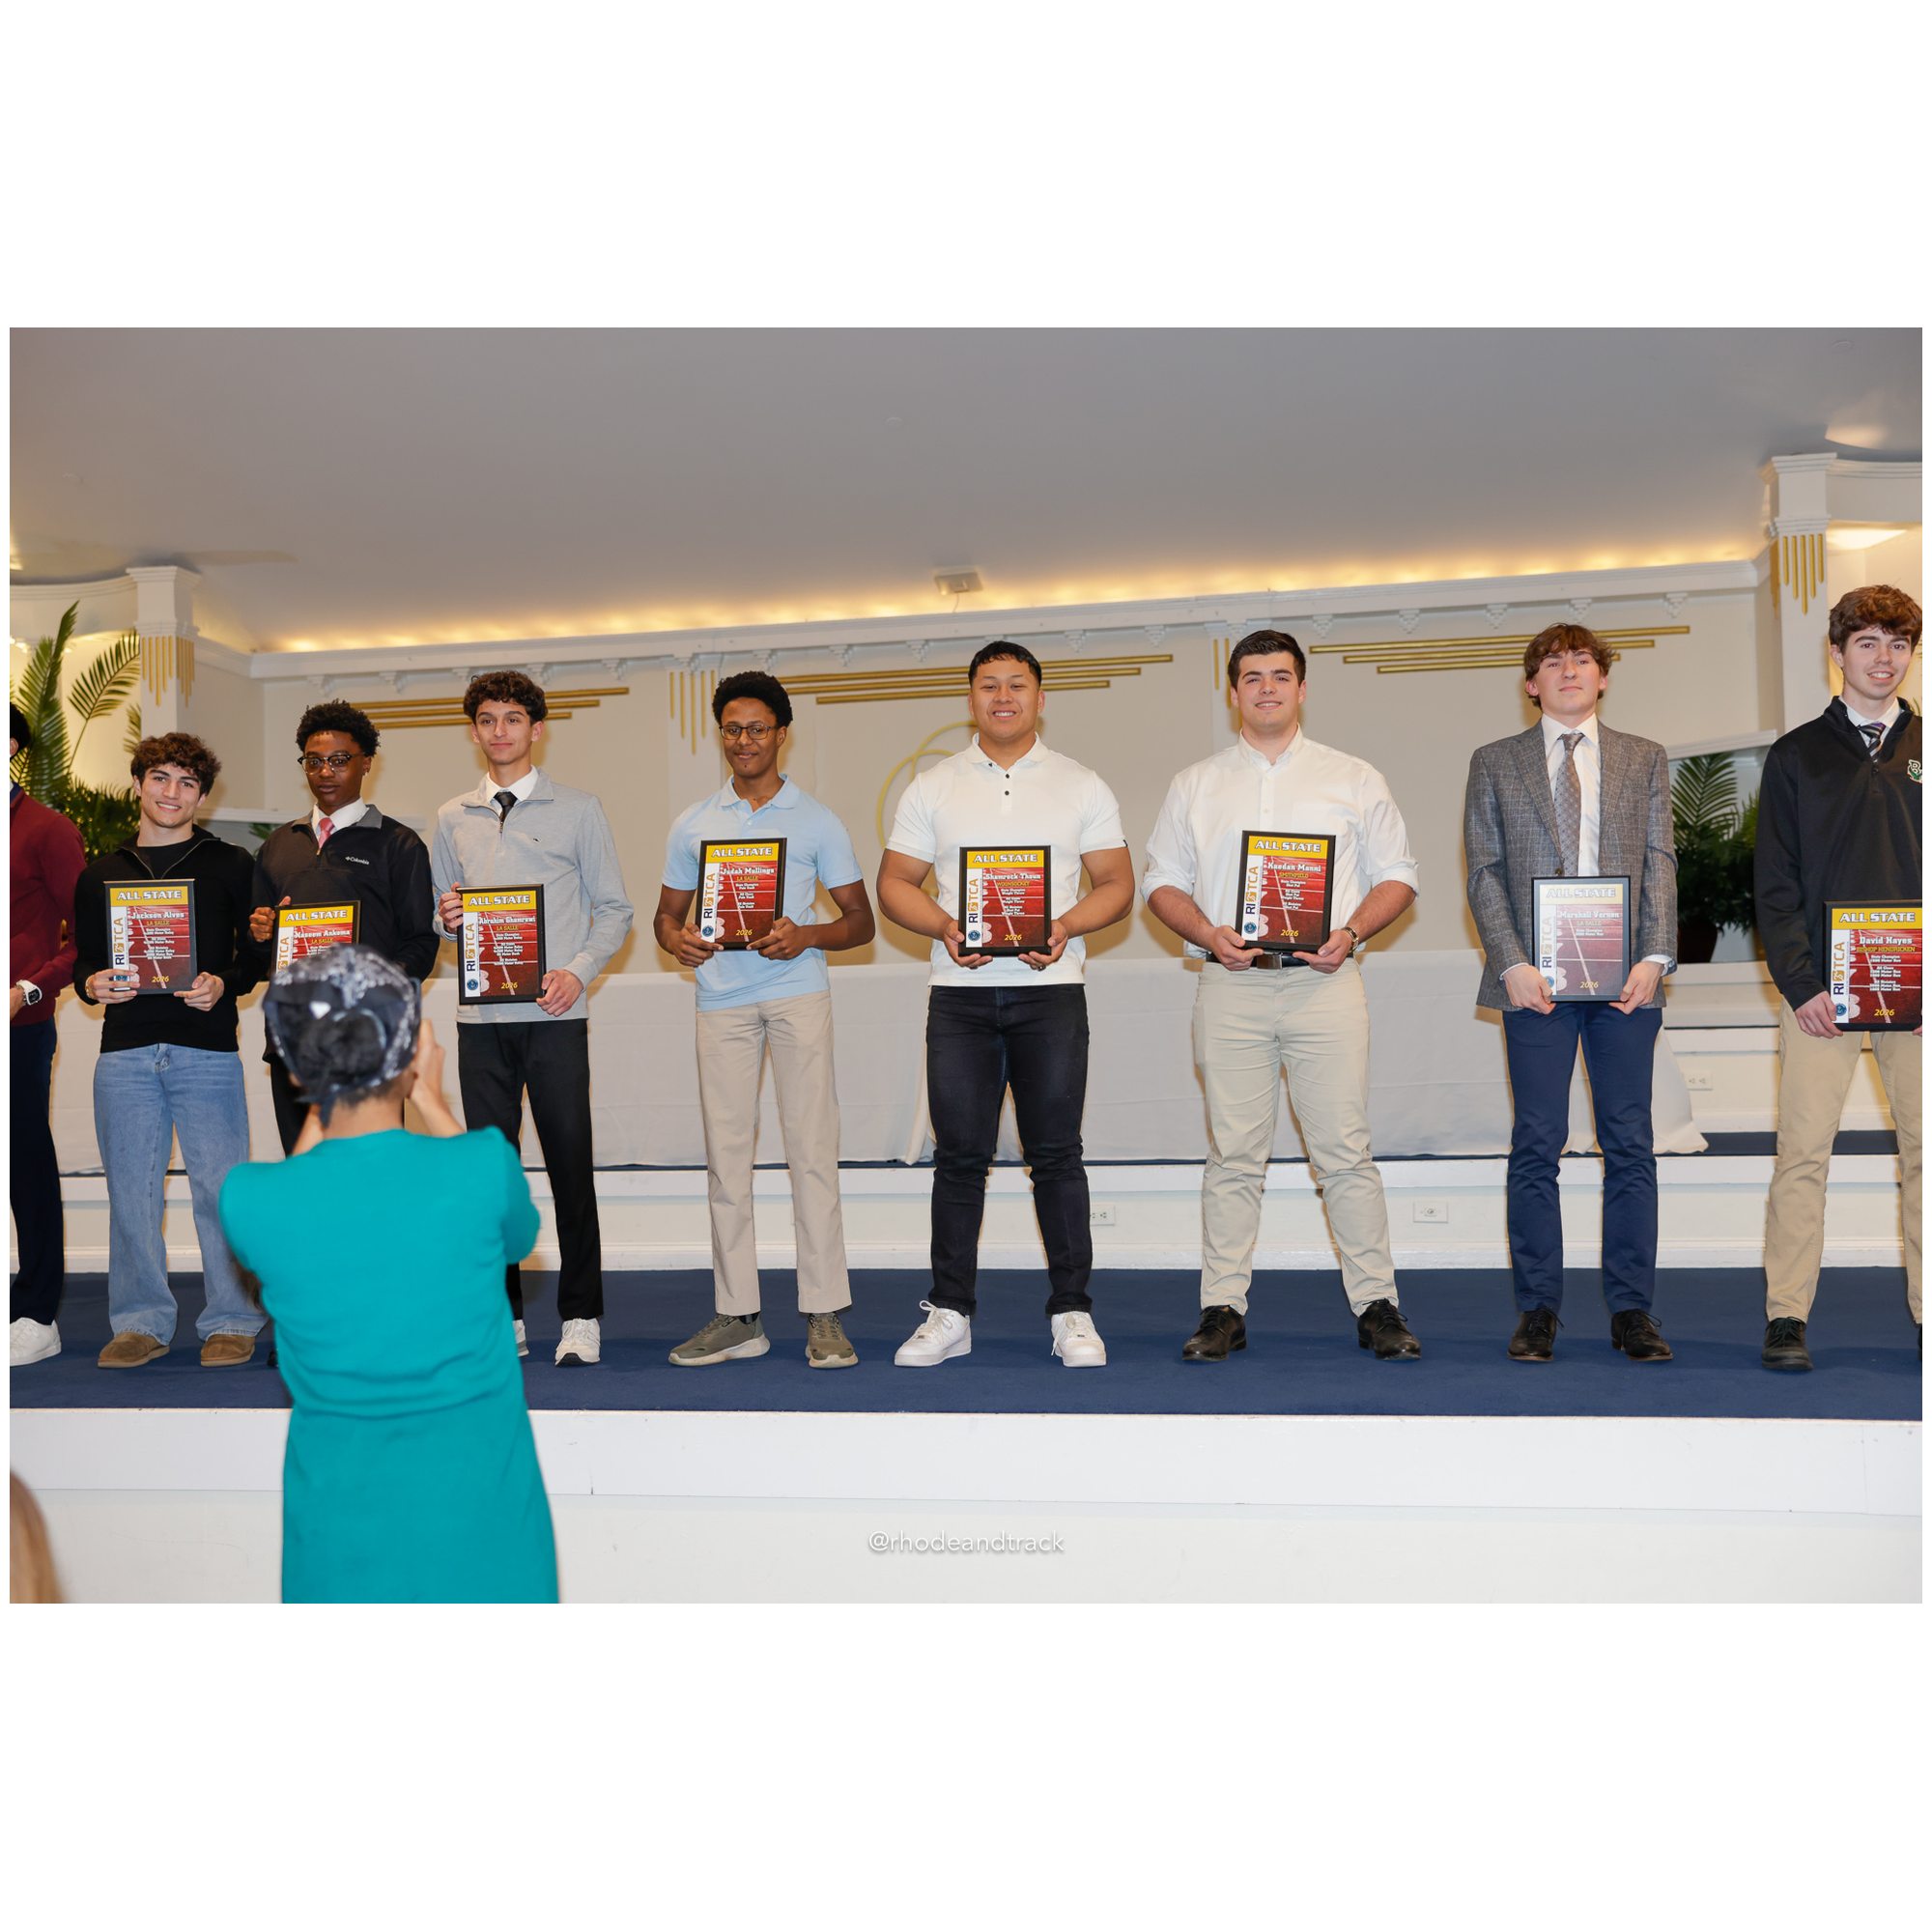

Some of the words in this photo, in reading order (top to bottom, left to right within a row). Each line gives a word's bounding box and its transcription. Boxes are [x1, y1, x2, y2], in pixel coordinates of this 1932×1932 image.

[1255, 839, 1280, 850] ALL
[1282, 842, 1321, 853] STATE
[712, 849, 734, 858] ALL
[736, 847, 773, 857] STATE
[350, 857, 370, 866] Columbia
[974, 854, 997, 863] ALL
[999, 854, 1037, 863] STATE
[745, 867, 774, 875] Mullings
[1267, 862, 1295, 870] Kaedan
[1297, 864, 1321, 872] Manni
[117, 892, 141, 900] ALL
[143, 890, 182, 899] STATE
[1547, 889, 1573, 897] ALL
[1575, 888, 1616, 897] STATE
[469, 895, 493, 906] ALL
[494, 895, 530, 904] STATE
[285, 912, 308, 922] ALL
[310, 909, 348, 920] STATE
[1839, 913, 1867, 923] ALL
[1870, 912, 1916, 923] STATE
[1860, 936, 1884, 945] David
[1886, 937, 1913, 946] Hayes
[500, 981, 519, 990] 2026
[1579, 980, 1599, 989] 2026
